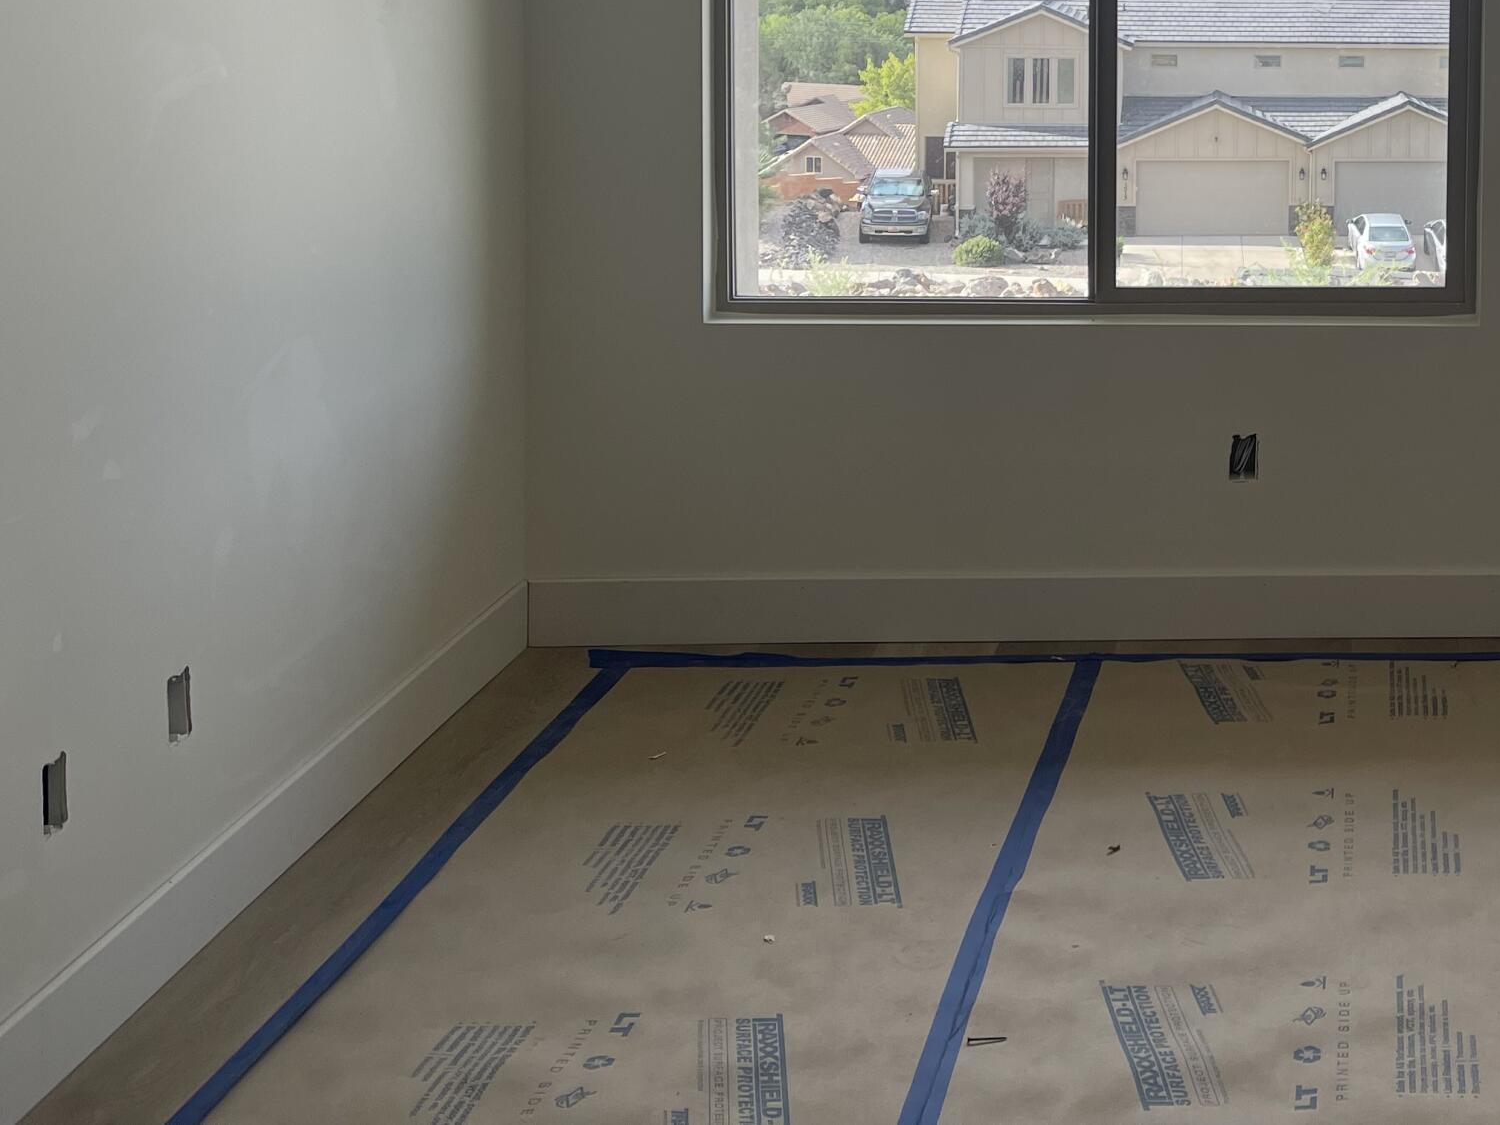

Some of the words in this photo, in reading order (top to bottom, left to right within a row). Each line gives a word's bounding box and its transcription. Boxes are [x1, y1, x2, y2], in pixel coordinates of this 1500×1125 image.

[744, 815, 768, 831] LT
[1308, 865, 1328, 885] LT
[1340, 979, 1352, 996] UP
[608, 1011, 642, 1037] LT
[1132, 985, 1171, 1049] PROTECTION
[1339, 999, 1352, 1034] SIDE
[735, 1017, 752, 1063] SURFACE
[1099, 979, 1174, 1112] TRAXXSHIELD-LT
[1158, 1050, 1192, 1107] SURFACE
[1336, 1042, 1352, 1102] PRINTED
[1294, 1084, 1318, 1111] LT
